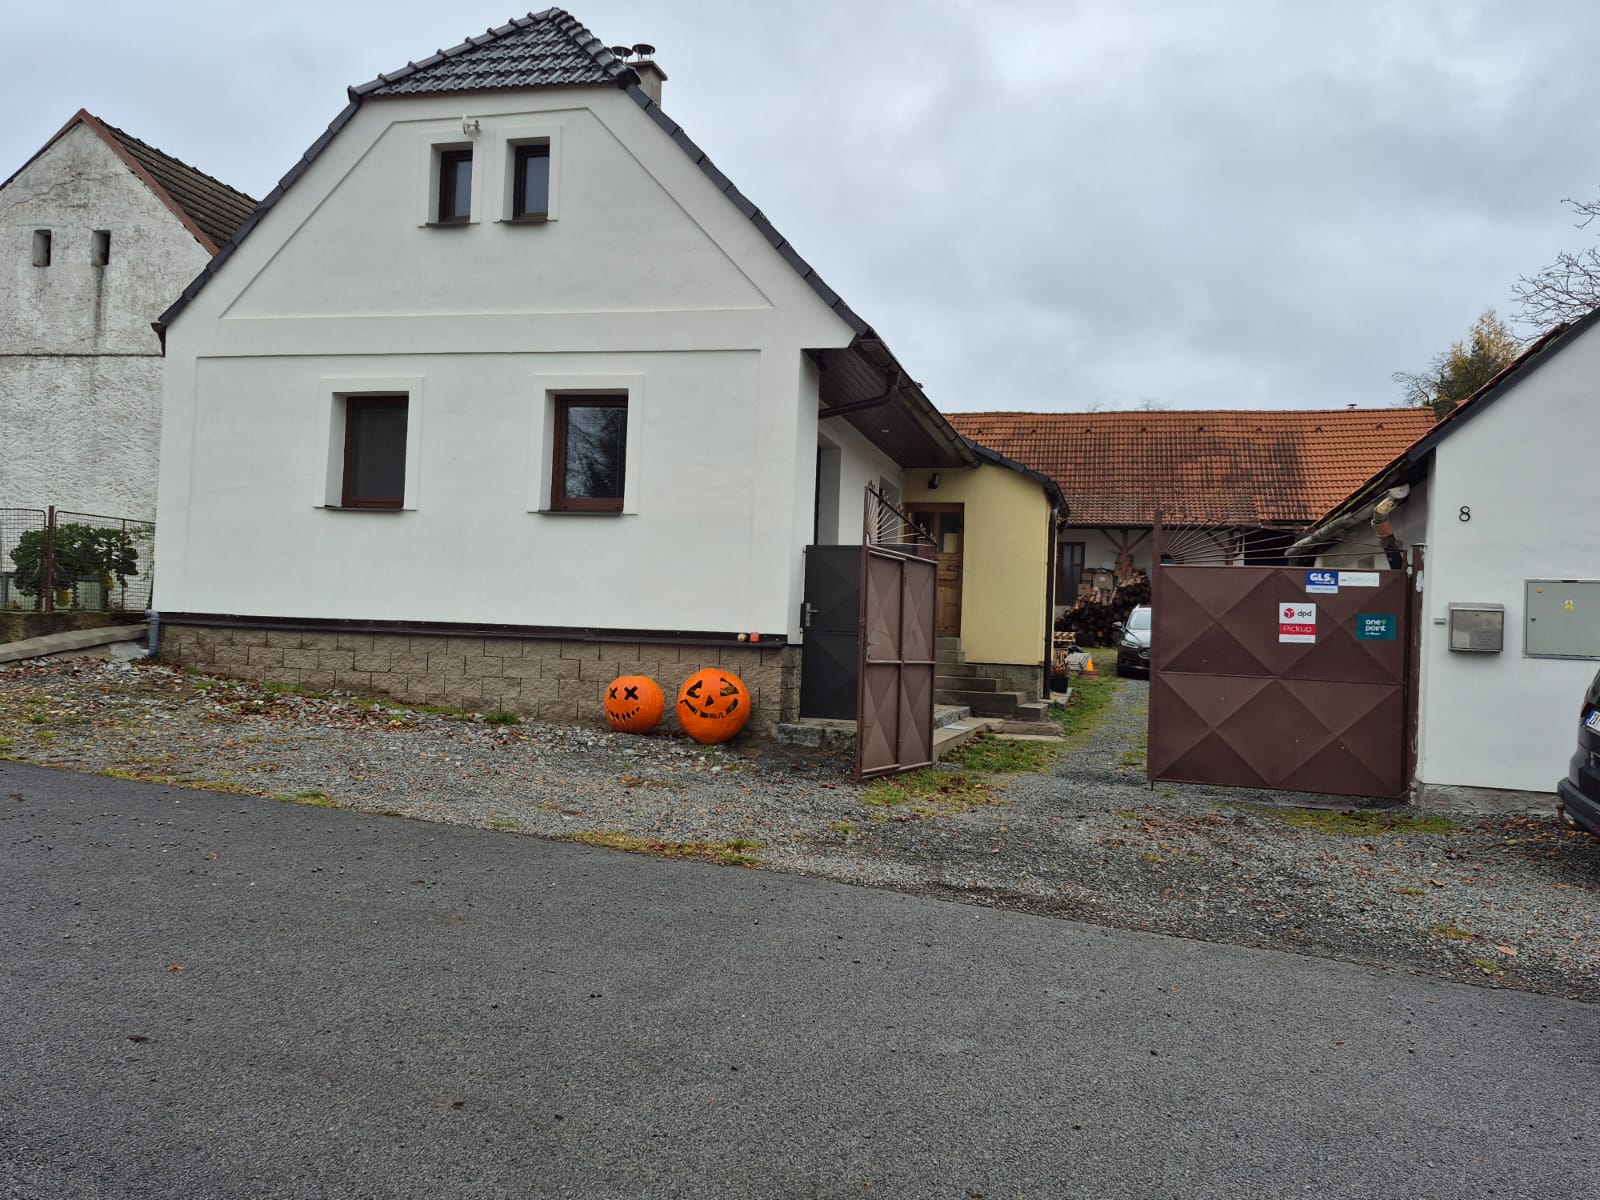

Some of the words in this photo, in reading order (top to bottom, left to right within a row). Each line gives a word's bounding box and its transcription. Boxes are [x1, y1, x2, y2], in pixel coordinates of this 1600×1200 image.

[1459, 505, 1471, 522] 8
[1297, 610, 1312, 618] dpd
[1283, 625, 1312, 633] Pickup
